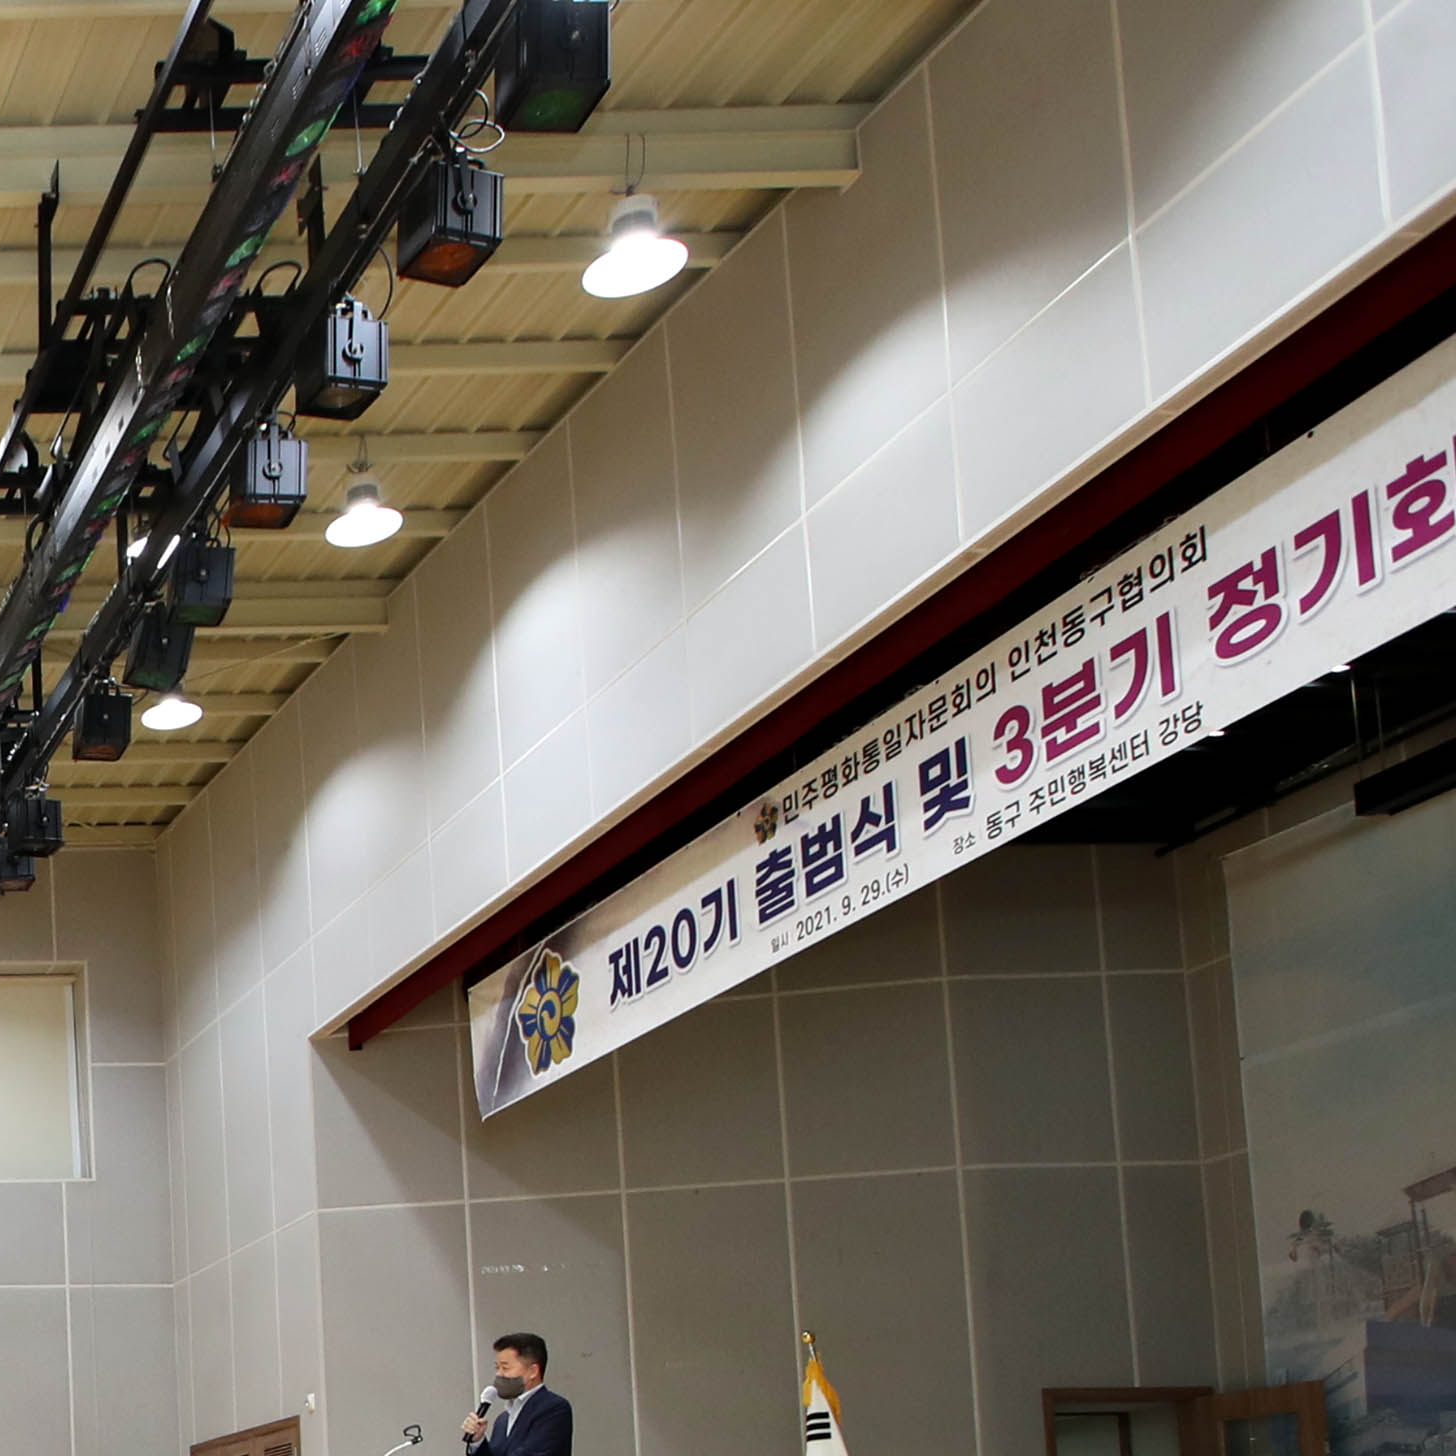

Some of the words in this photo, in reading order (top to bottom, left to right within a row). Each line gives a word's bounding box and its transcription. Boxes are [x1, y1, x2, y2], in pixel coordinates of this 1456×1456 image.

[783, 662, 996, 824] 민주평화통일자문회의
[1008, 525, 1207, 682] 인천동구협의회
[952, 832, 976, 854] 장소
[986, 800, 1021, 839] 동구
[1029, 730, 1150, 812] 주민행복센터
[1159, 701, 1203, 746] 강당
[608, 878, 739, 1006] 제20기
[755, 782, 898, 925] 출범식
[919, 736, 970, 831] 및
[994, 611, 1175, 784] 3분기
[796, 906, 837, 941] 2021.
[842, 896, 856, 915] 9.
